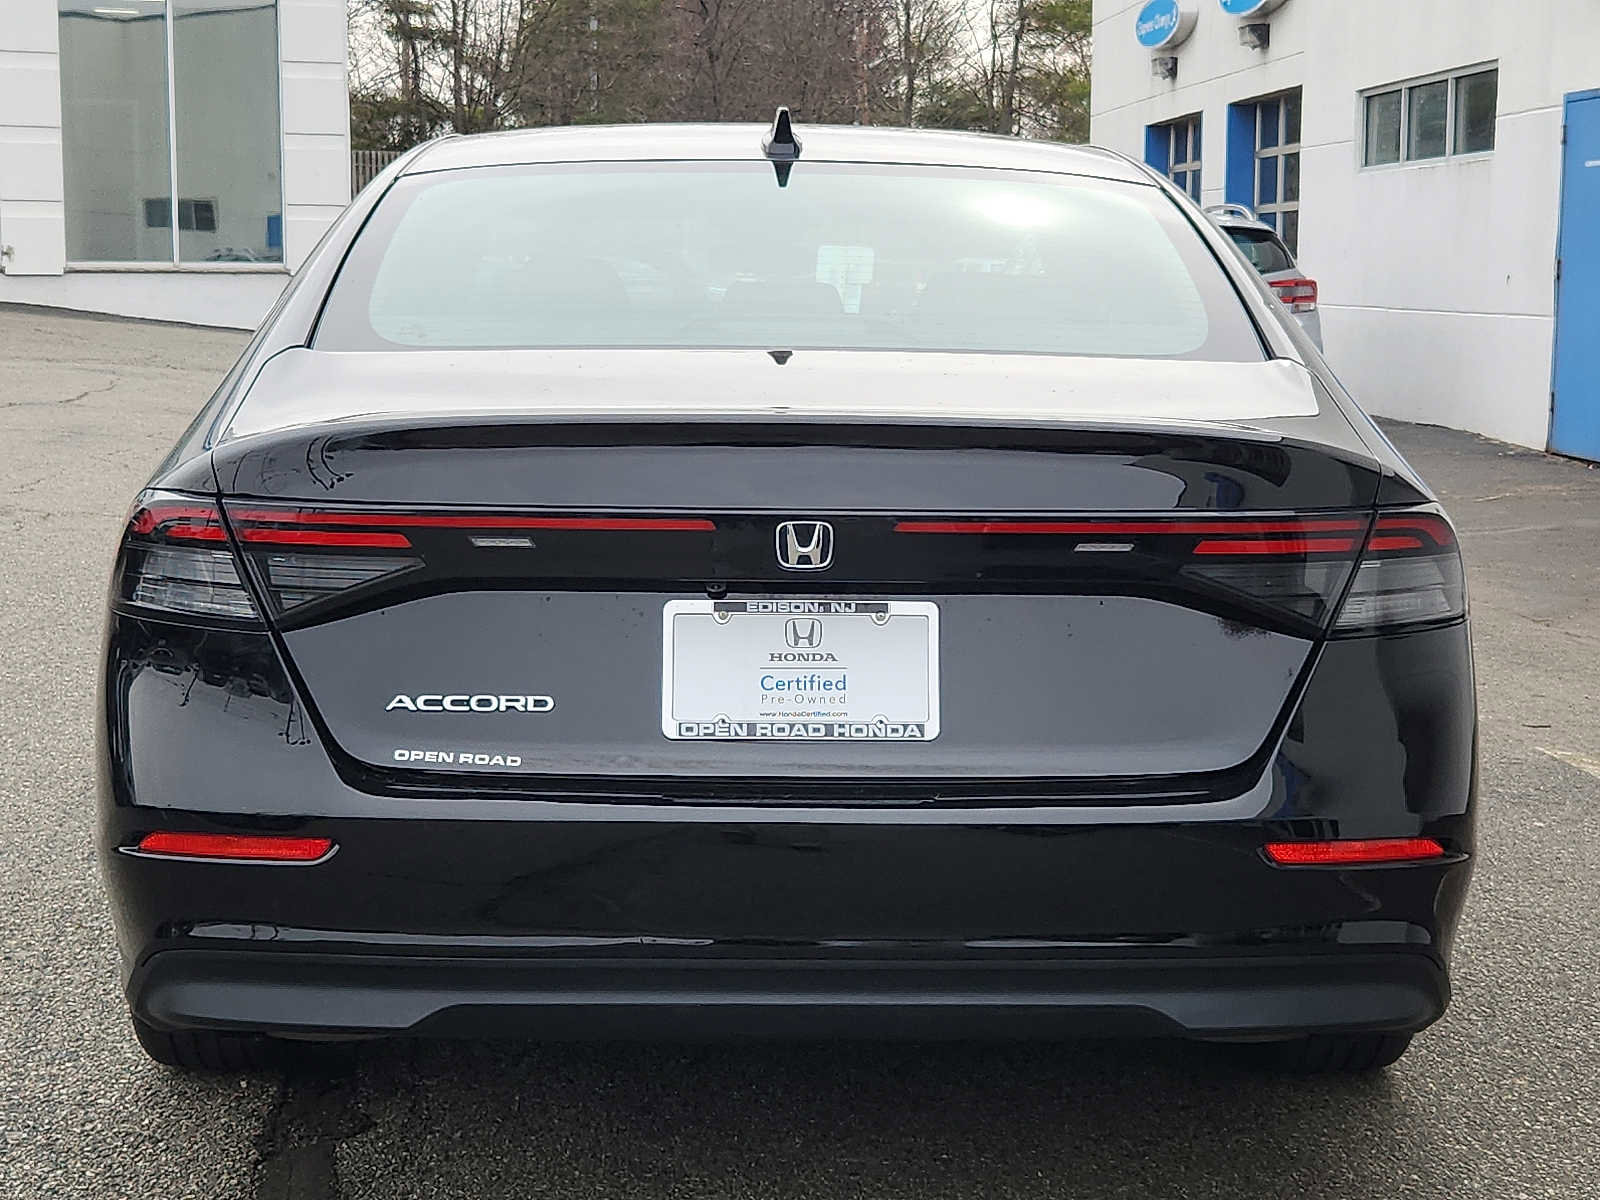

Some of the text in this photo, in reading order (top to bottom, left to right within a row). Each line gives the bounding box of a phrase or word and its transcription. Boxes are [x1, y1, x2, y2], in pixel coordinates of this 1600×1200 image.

[746, 602, 856, 613] EDISON, NJ
[768, 652, 839, 662] HONDA
[760, 674, 846, 691] Certified
[385, 694, 555, 712] ACCORD
[761, 693, 846, 704] Pre-Owned
[679, 723, 922, 738] OPEN ROAD HONDA
[394, 749, 522, 767] OPEN ROAD
